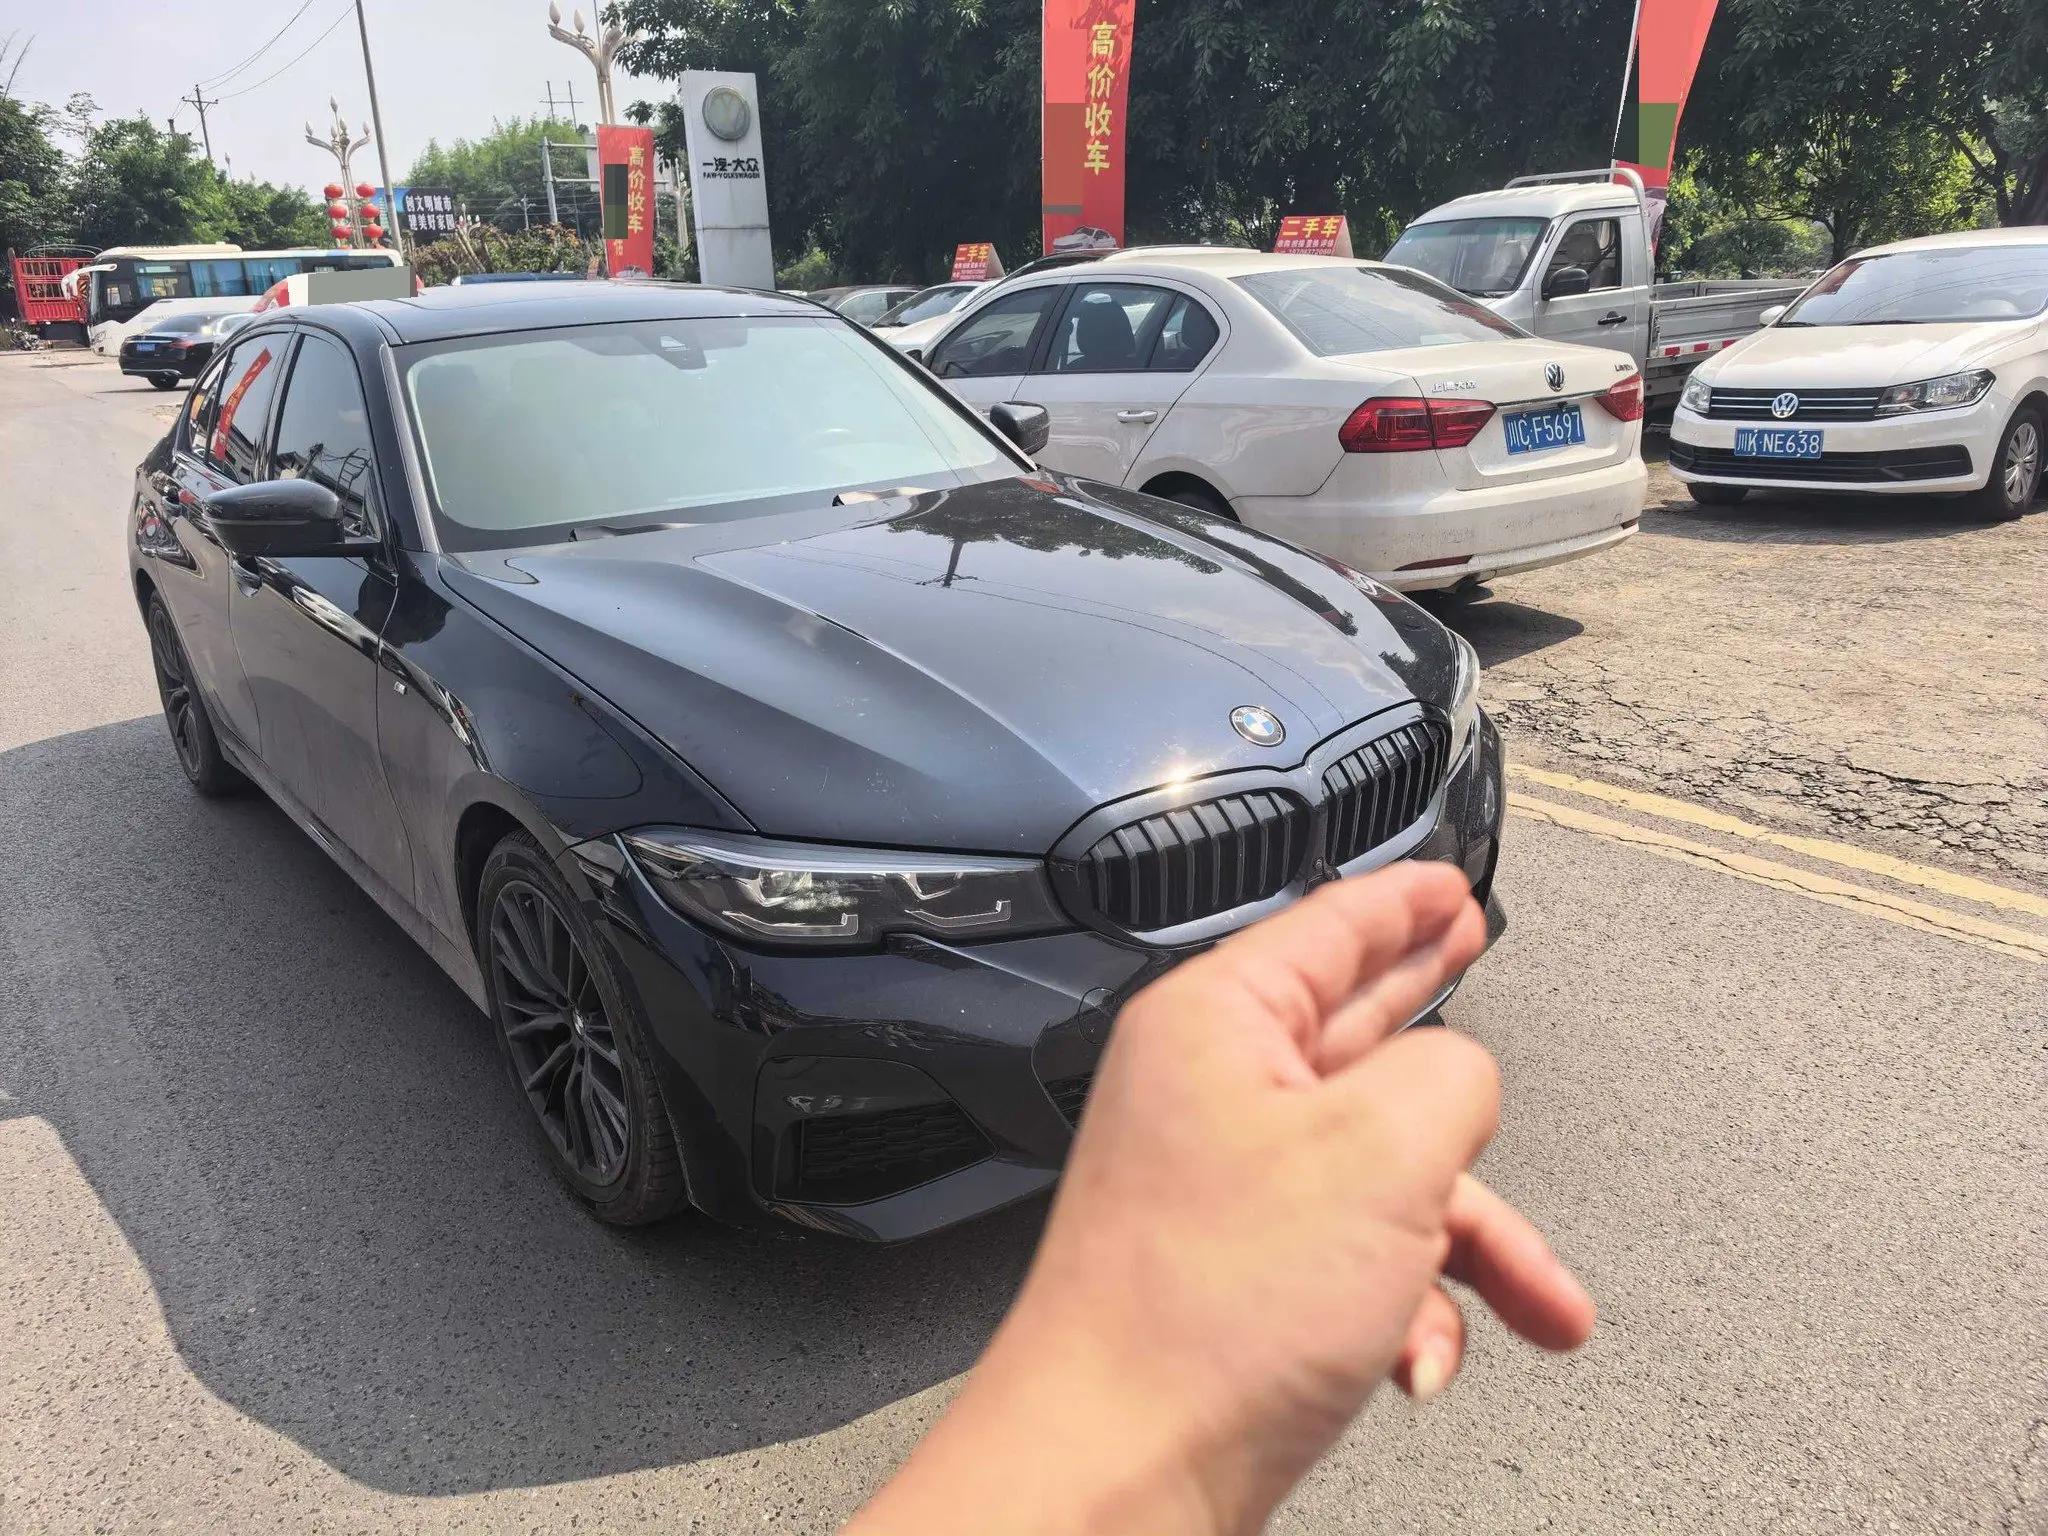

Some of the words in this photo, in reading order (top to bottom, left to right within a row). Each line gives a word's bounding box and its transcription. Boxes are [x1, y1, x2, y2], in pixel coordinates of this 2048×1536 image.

[1084, 21, 1117, 176] 高价收车
[627, 146, 646, 234] 高价收车
[405, 195, 452, 212] 创文明城市
[408, 213, 455, 231] 建美好家园
[1282, 217, 1339, 239] 二手车
[955, 244, 990, 262] 二手车
